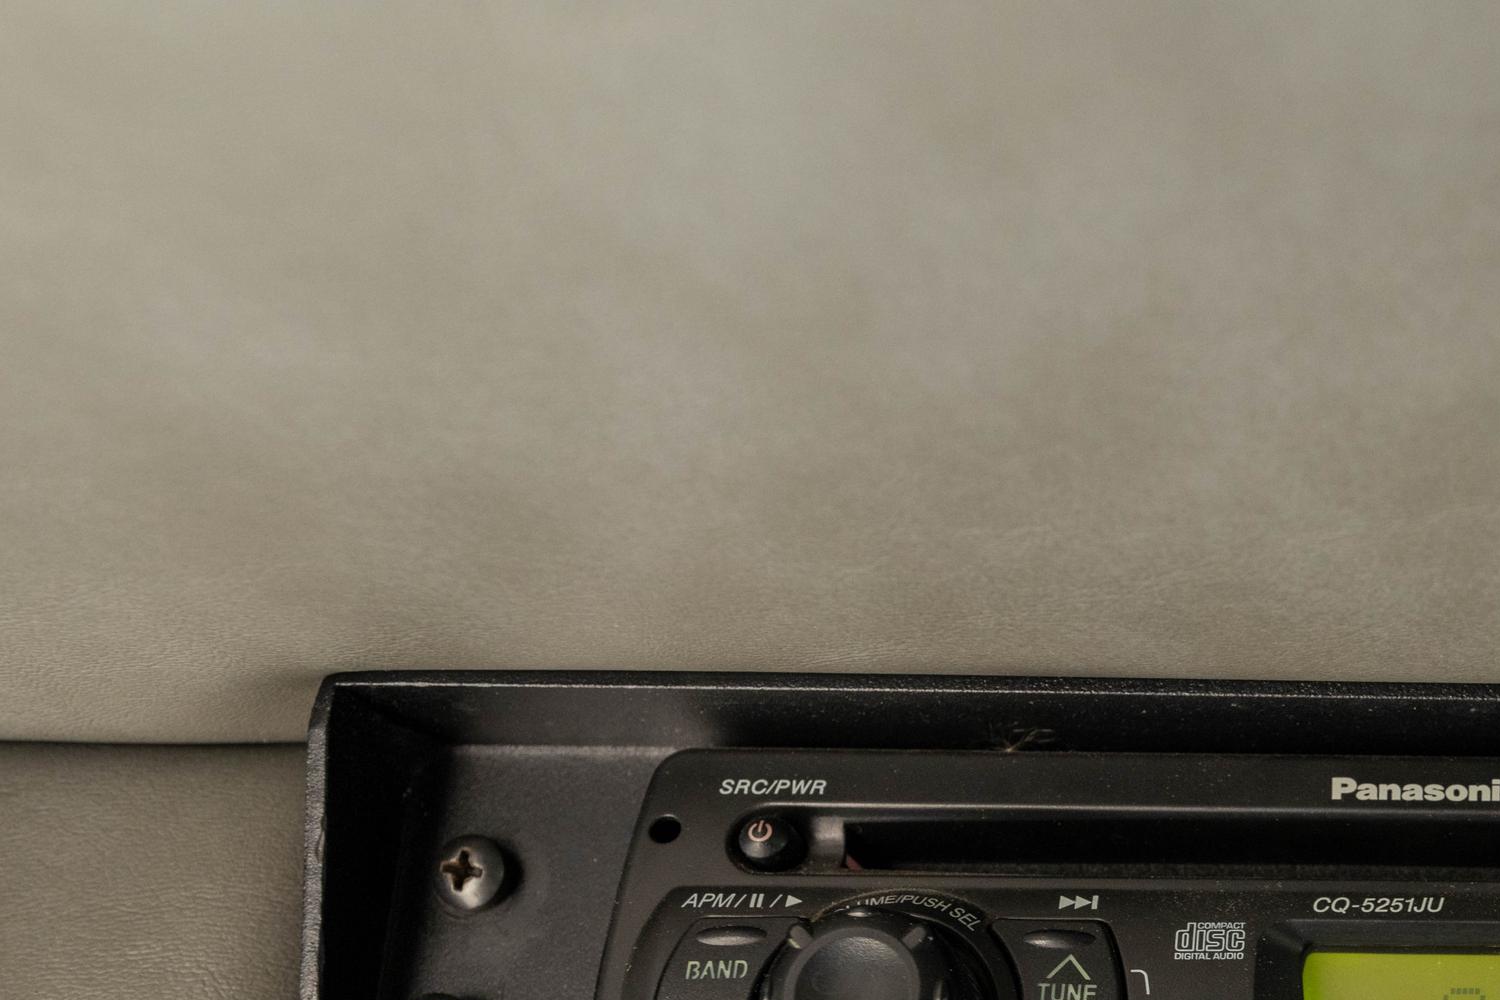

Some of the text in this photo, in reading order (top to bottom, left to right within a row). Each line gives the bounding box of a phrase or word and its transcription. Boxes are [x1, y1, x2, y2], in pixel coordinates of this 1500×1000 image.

[719, 779, 827, 797] SRC/PWR
[1312, 896, 1445, 914] CQ-5251JU
[948, 906, 982, 932] SEL
[1197, 922, 1246, 930] COMPACT
[1174, 922, 1246, 952] disc
[1174, 952, 1245, 961] DIGITAL AUDIO
[685, 959, 748, 981] BAND
